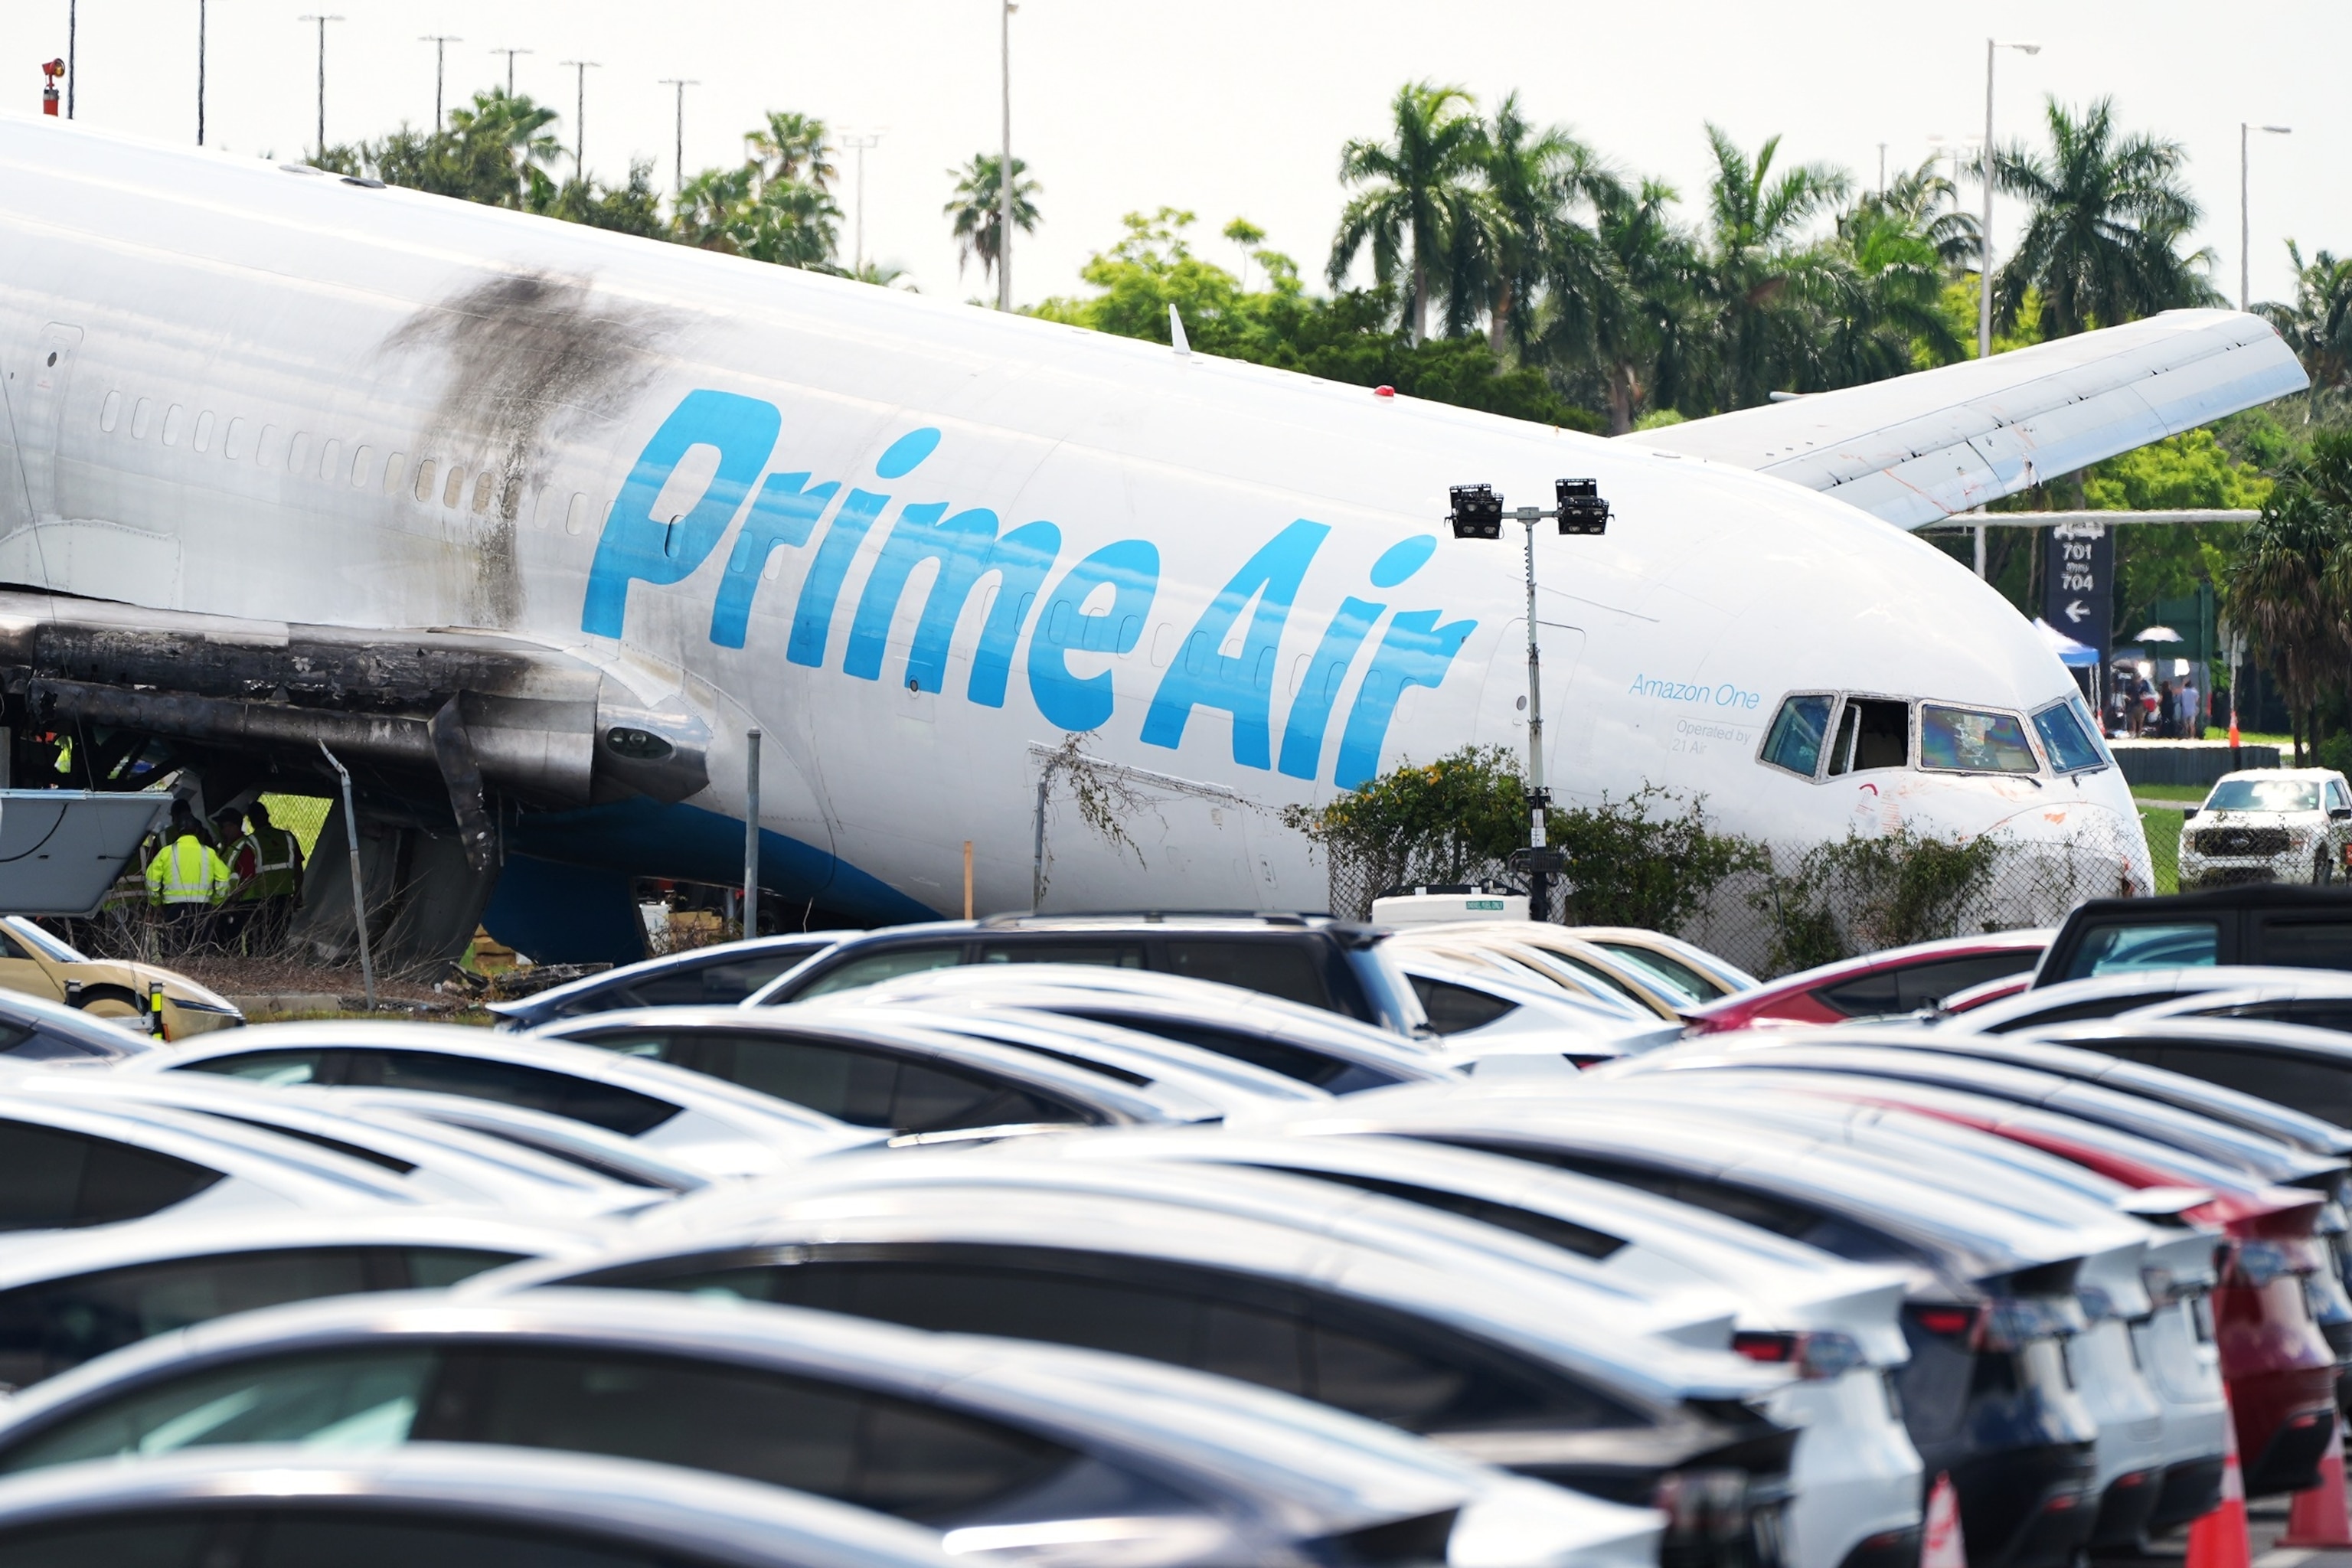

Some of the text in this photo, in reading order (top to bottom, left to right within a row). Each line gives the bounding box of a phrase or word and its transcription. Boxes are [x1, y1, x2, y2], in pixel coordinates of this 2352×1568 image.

[2062, 542, 2092, 560] 701
[580, 388, 1479, 792] Prime Air
[2060, 573, 2094, 592] 704
[1628, 673, 1760, 710] Amazon One
[1677, 719, 1752, 746] Operated by
[1671, 737, 1707, 754] 21 Air
